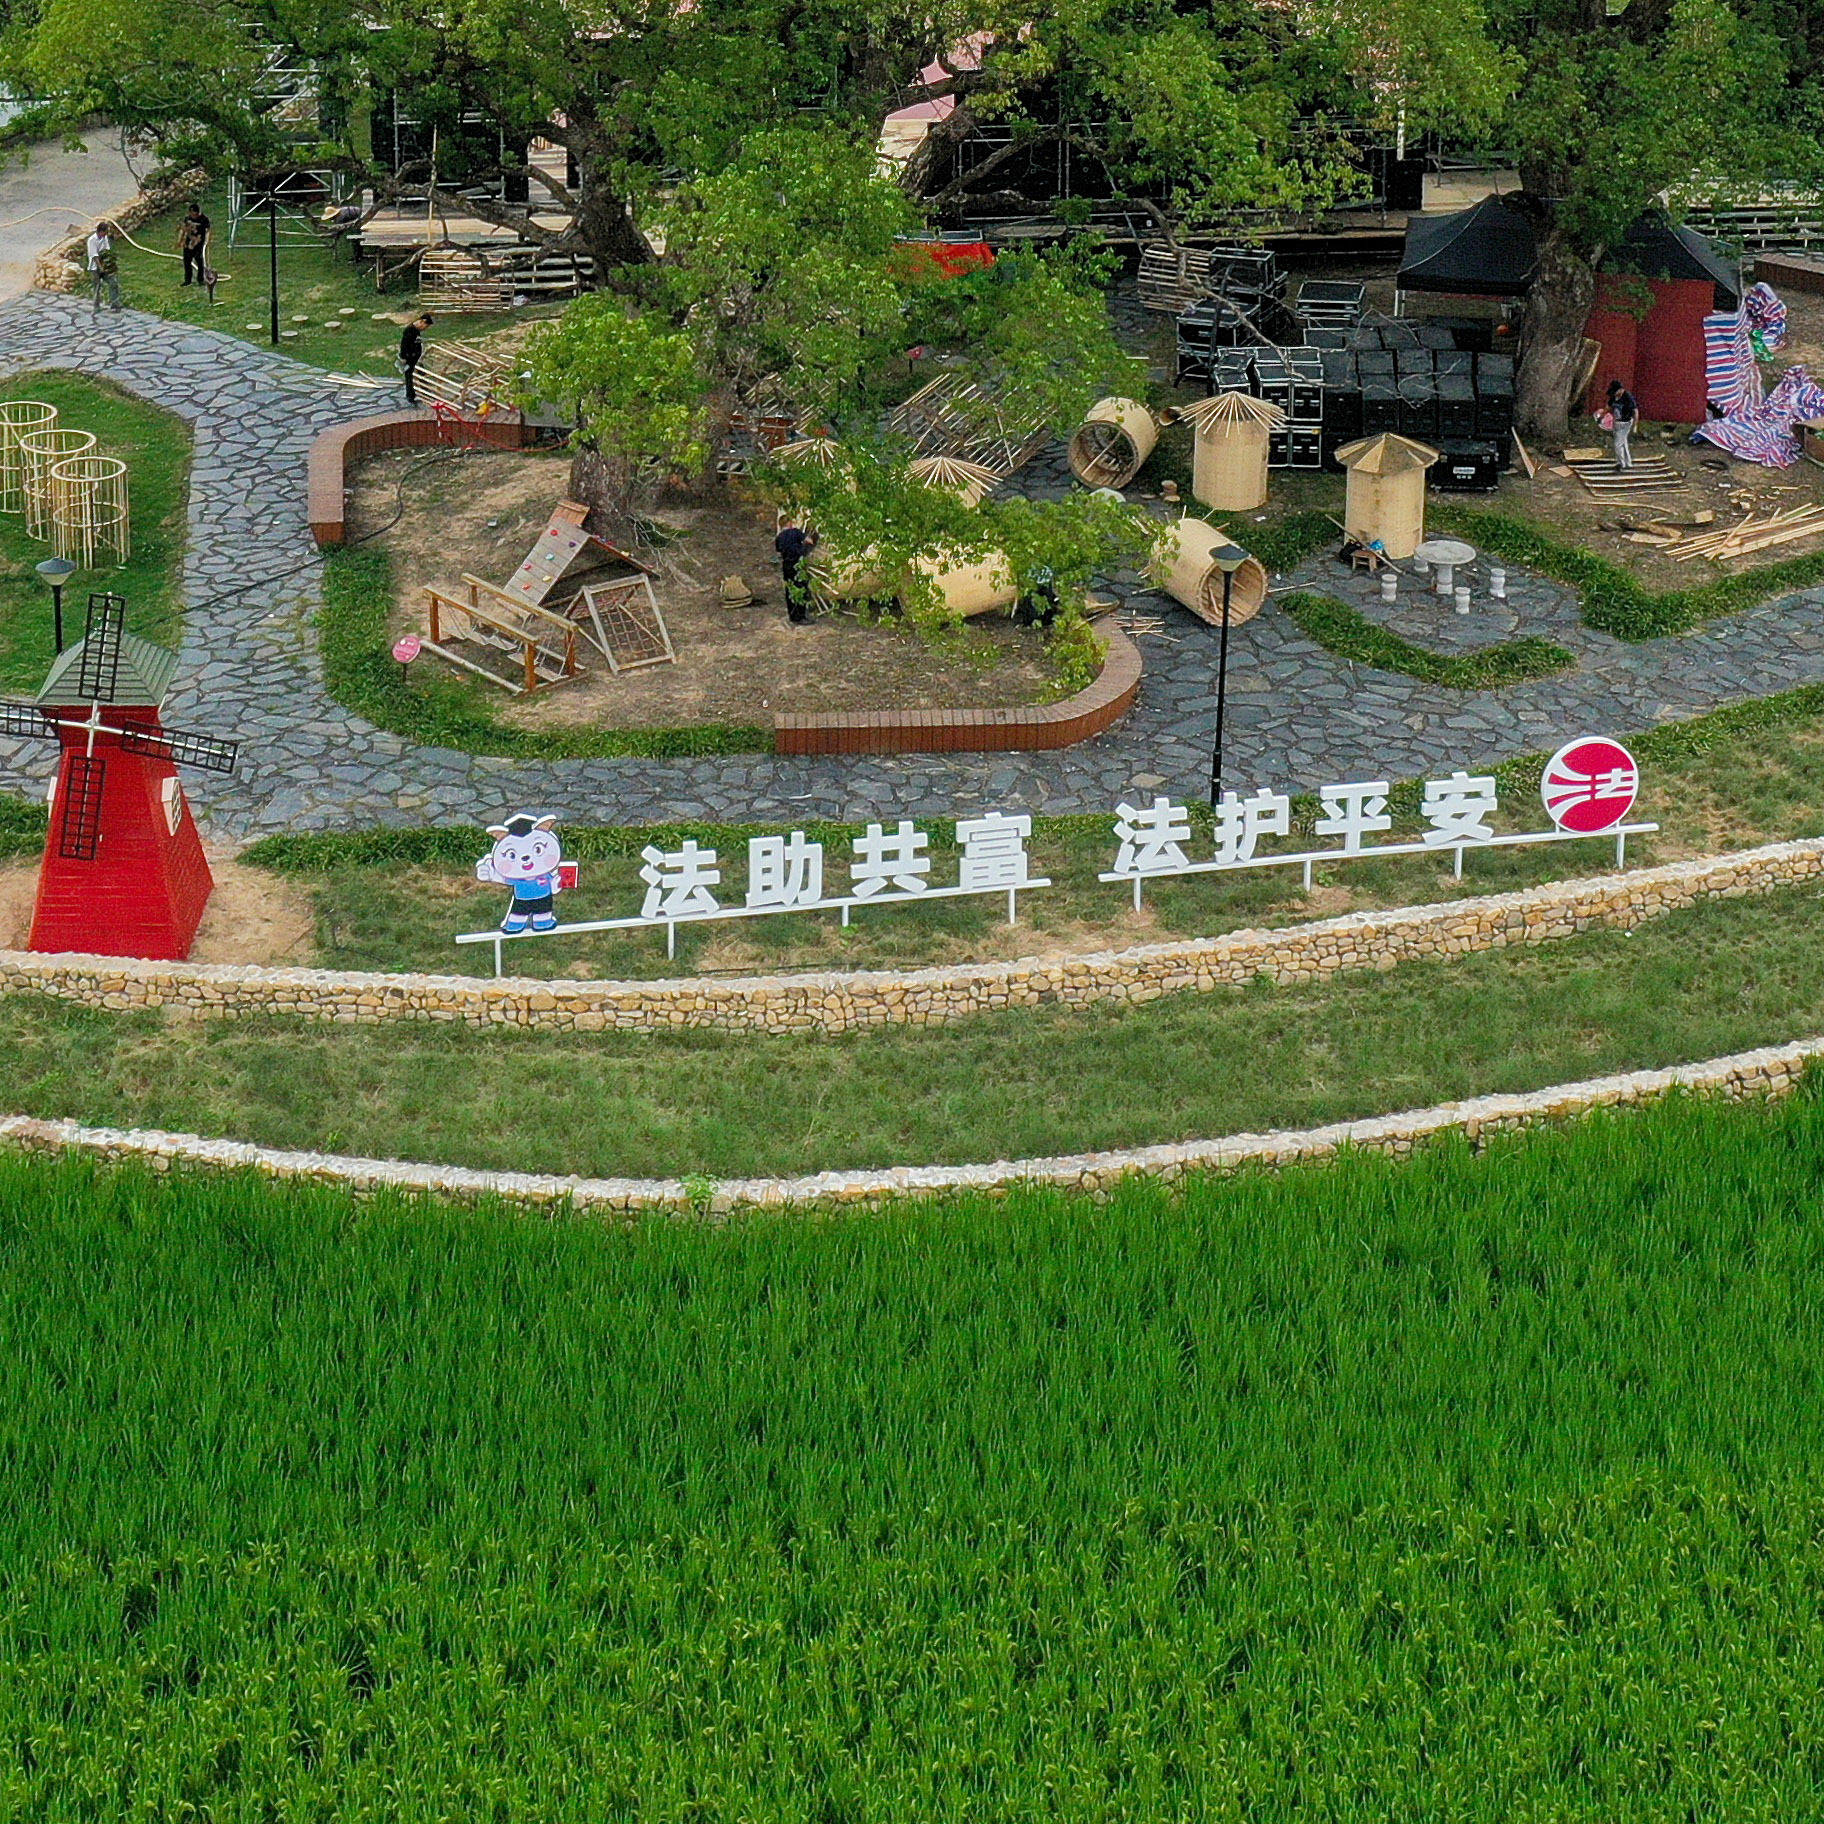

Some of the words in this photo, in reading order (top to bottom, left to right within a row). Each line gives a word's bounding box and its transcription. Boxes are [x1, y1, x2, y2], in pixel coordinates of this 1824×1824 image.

[639, 812, 1032, 919] 法助共富
[1113, 771, 1497, 874] 法护平安
